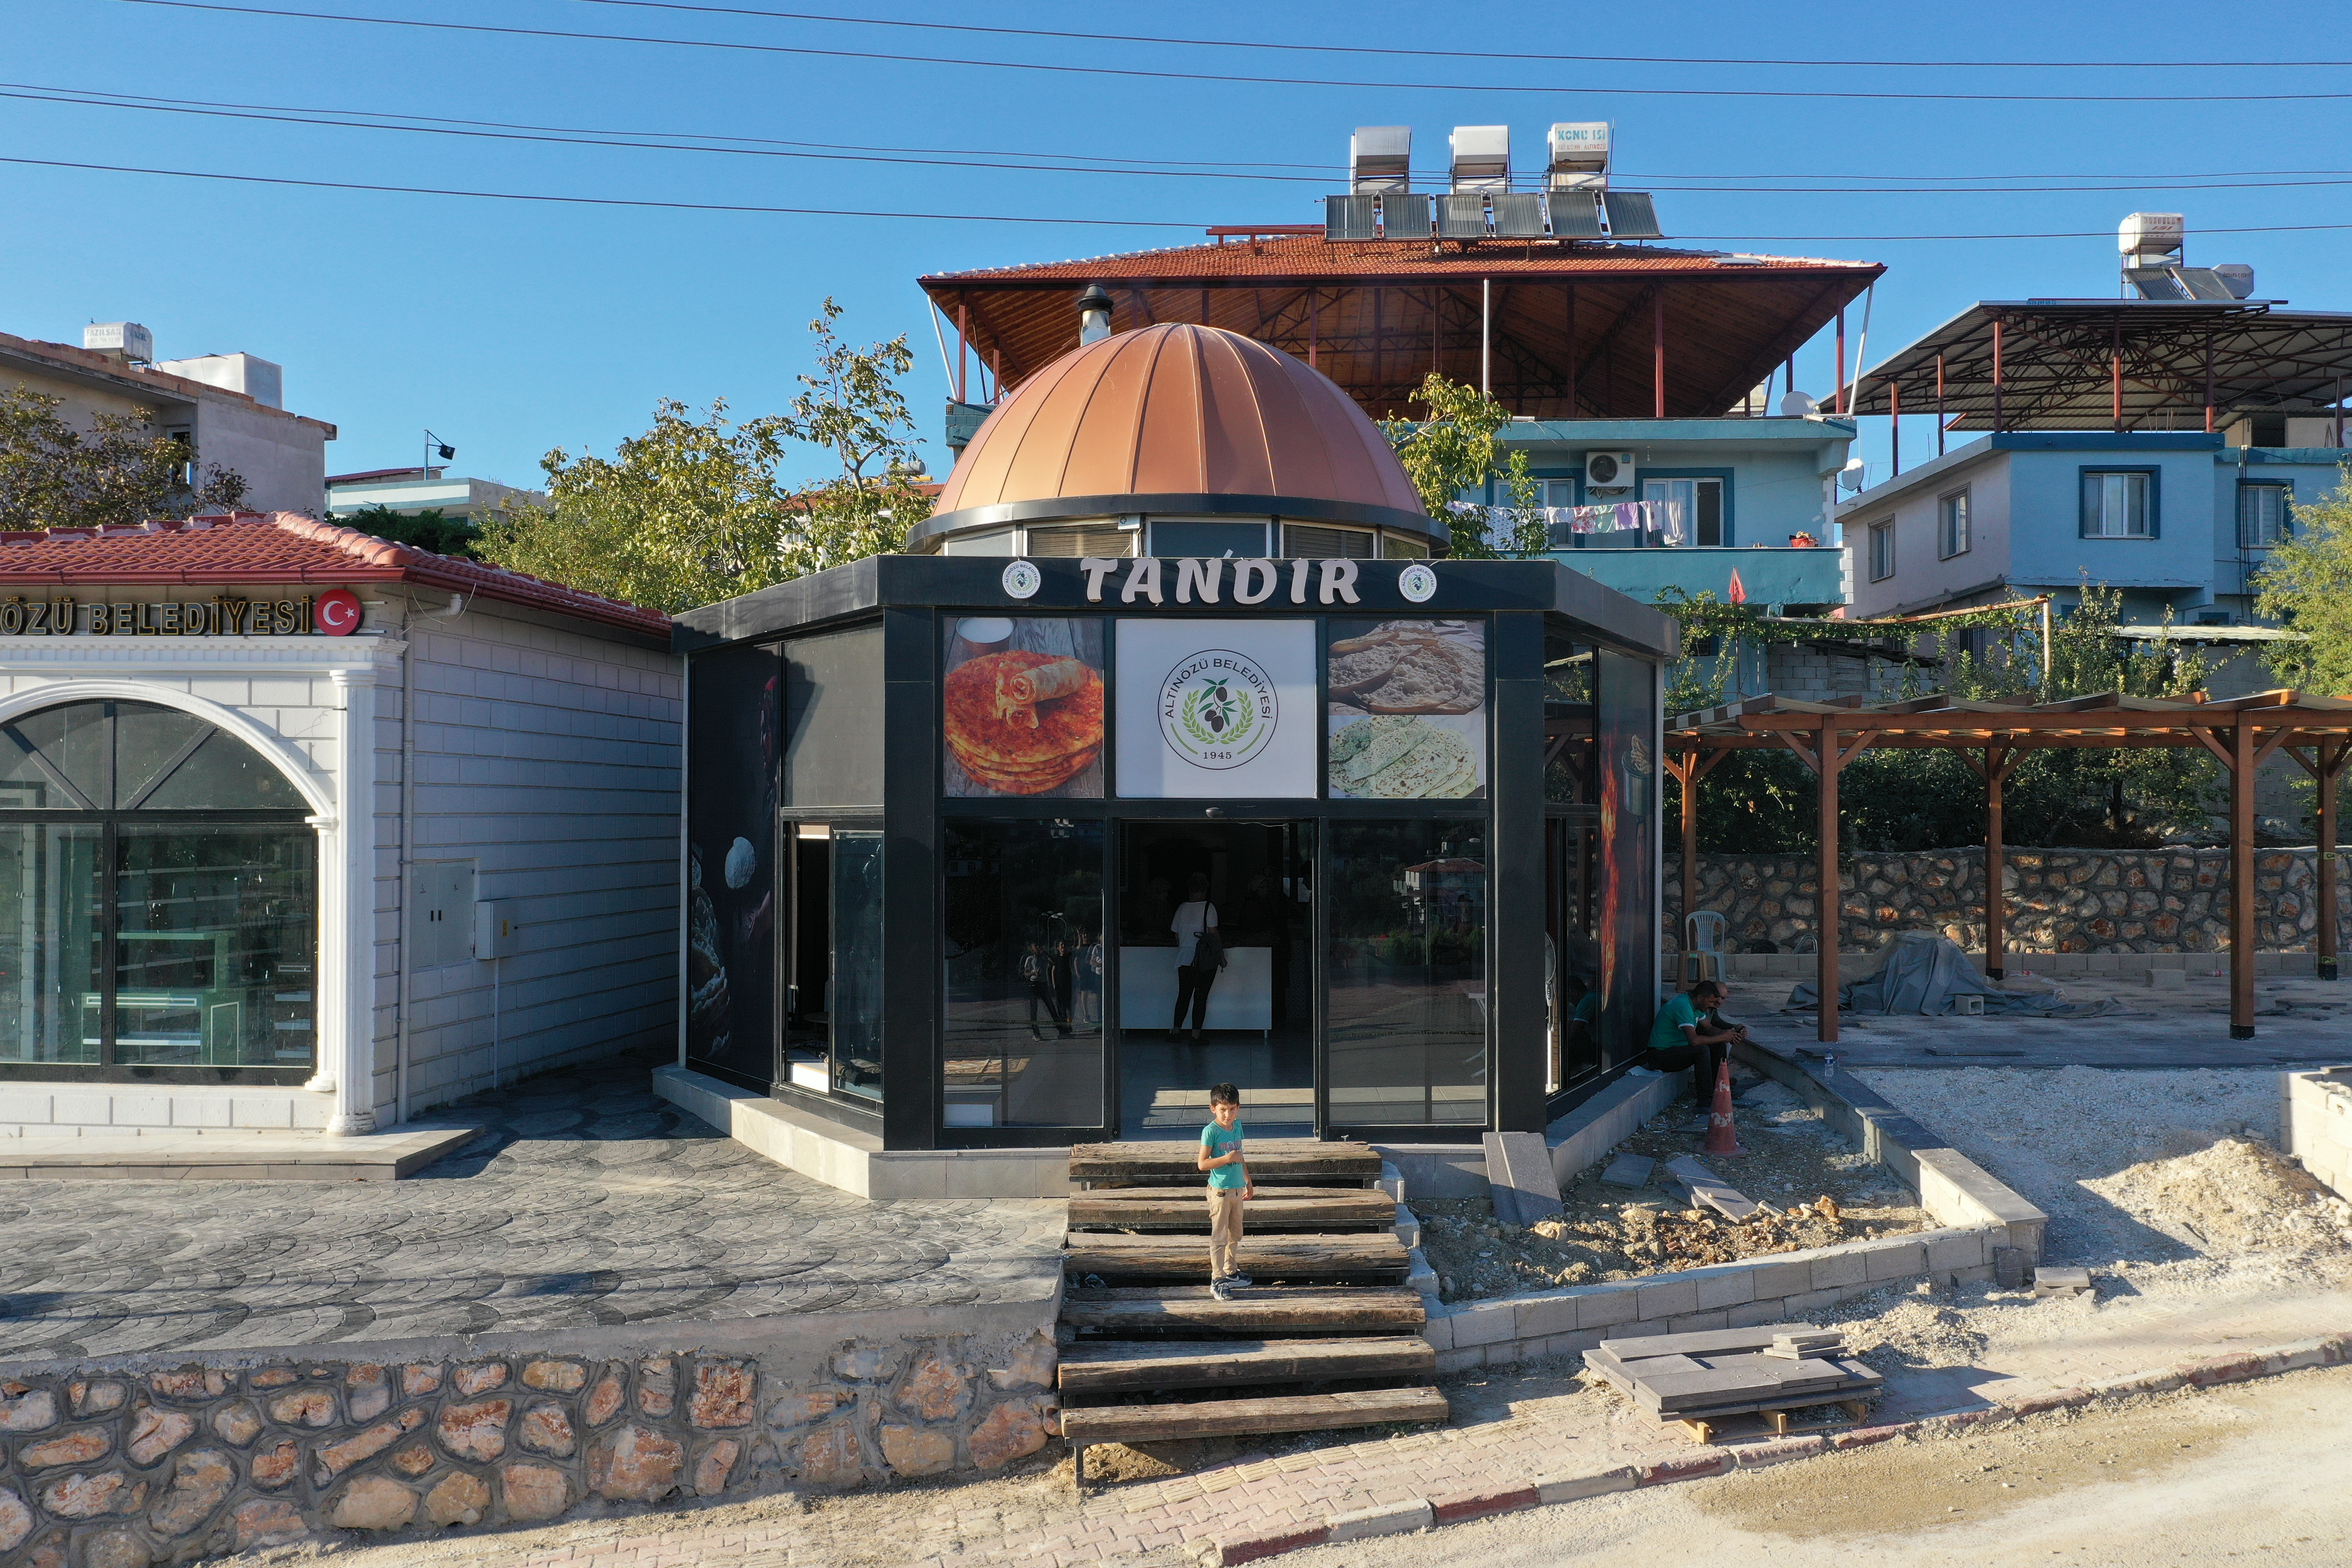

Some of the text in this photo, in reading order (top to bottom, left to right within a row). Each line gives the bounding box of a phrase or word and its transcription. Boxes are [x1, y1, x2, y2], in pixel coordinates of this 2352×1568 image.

[1558, 130, 1588, 141] KONU
[86, 328, 122, 337] FAZILSAN
[1080, 558, 1361, 604] TANDIR
[0, 594, 310, 635] ÖZÜ BELEDİYESİ
[1164, 658, 1273, 720] ALTINÖZÜ BELEDİYESİ
[1203, 751, 1232, 760] 1945
